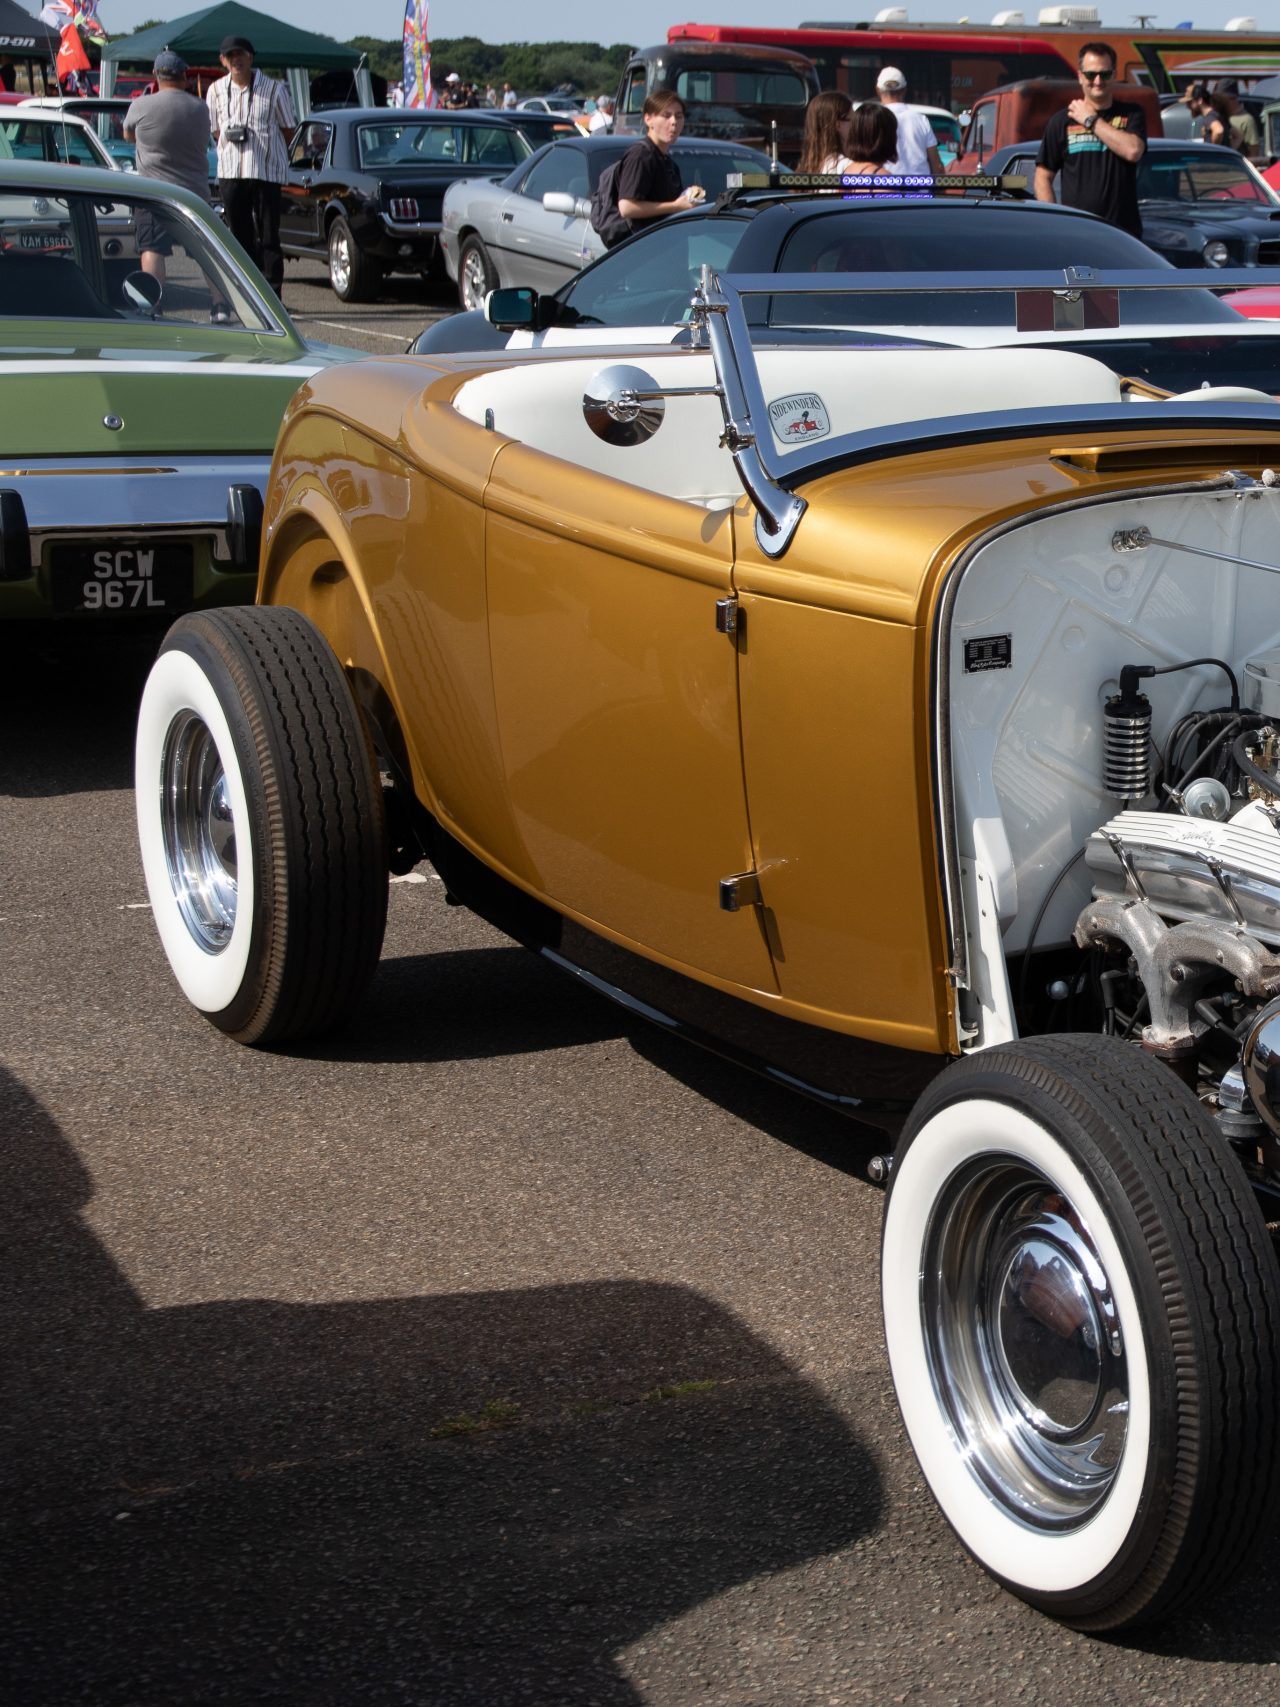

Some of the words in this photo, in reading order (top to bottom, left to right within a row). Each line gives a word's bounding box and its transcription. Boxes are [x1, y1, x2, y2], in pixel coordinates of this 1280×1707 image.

[770, 396, 823, 421] SIDEWINDERS
[93, 550, 155, 578] SCW
[83, 580, 166, 609] 967L
